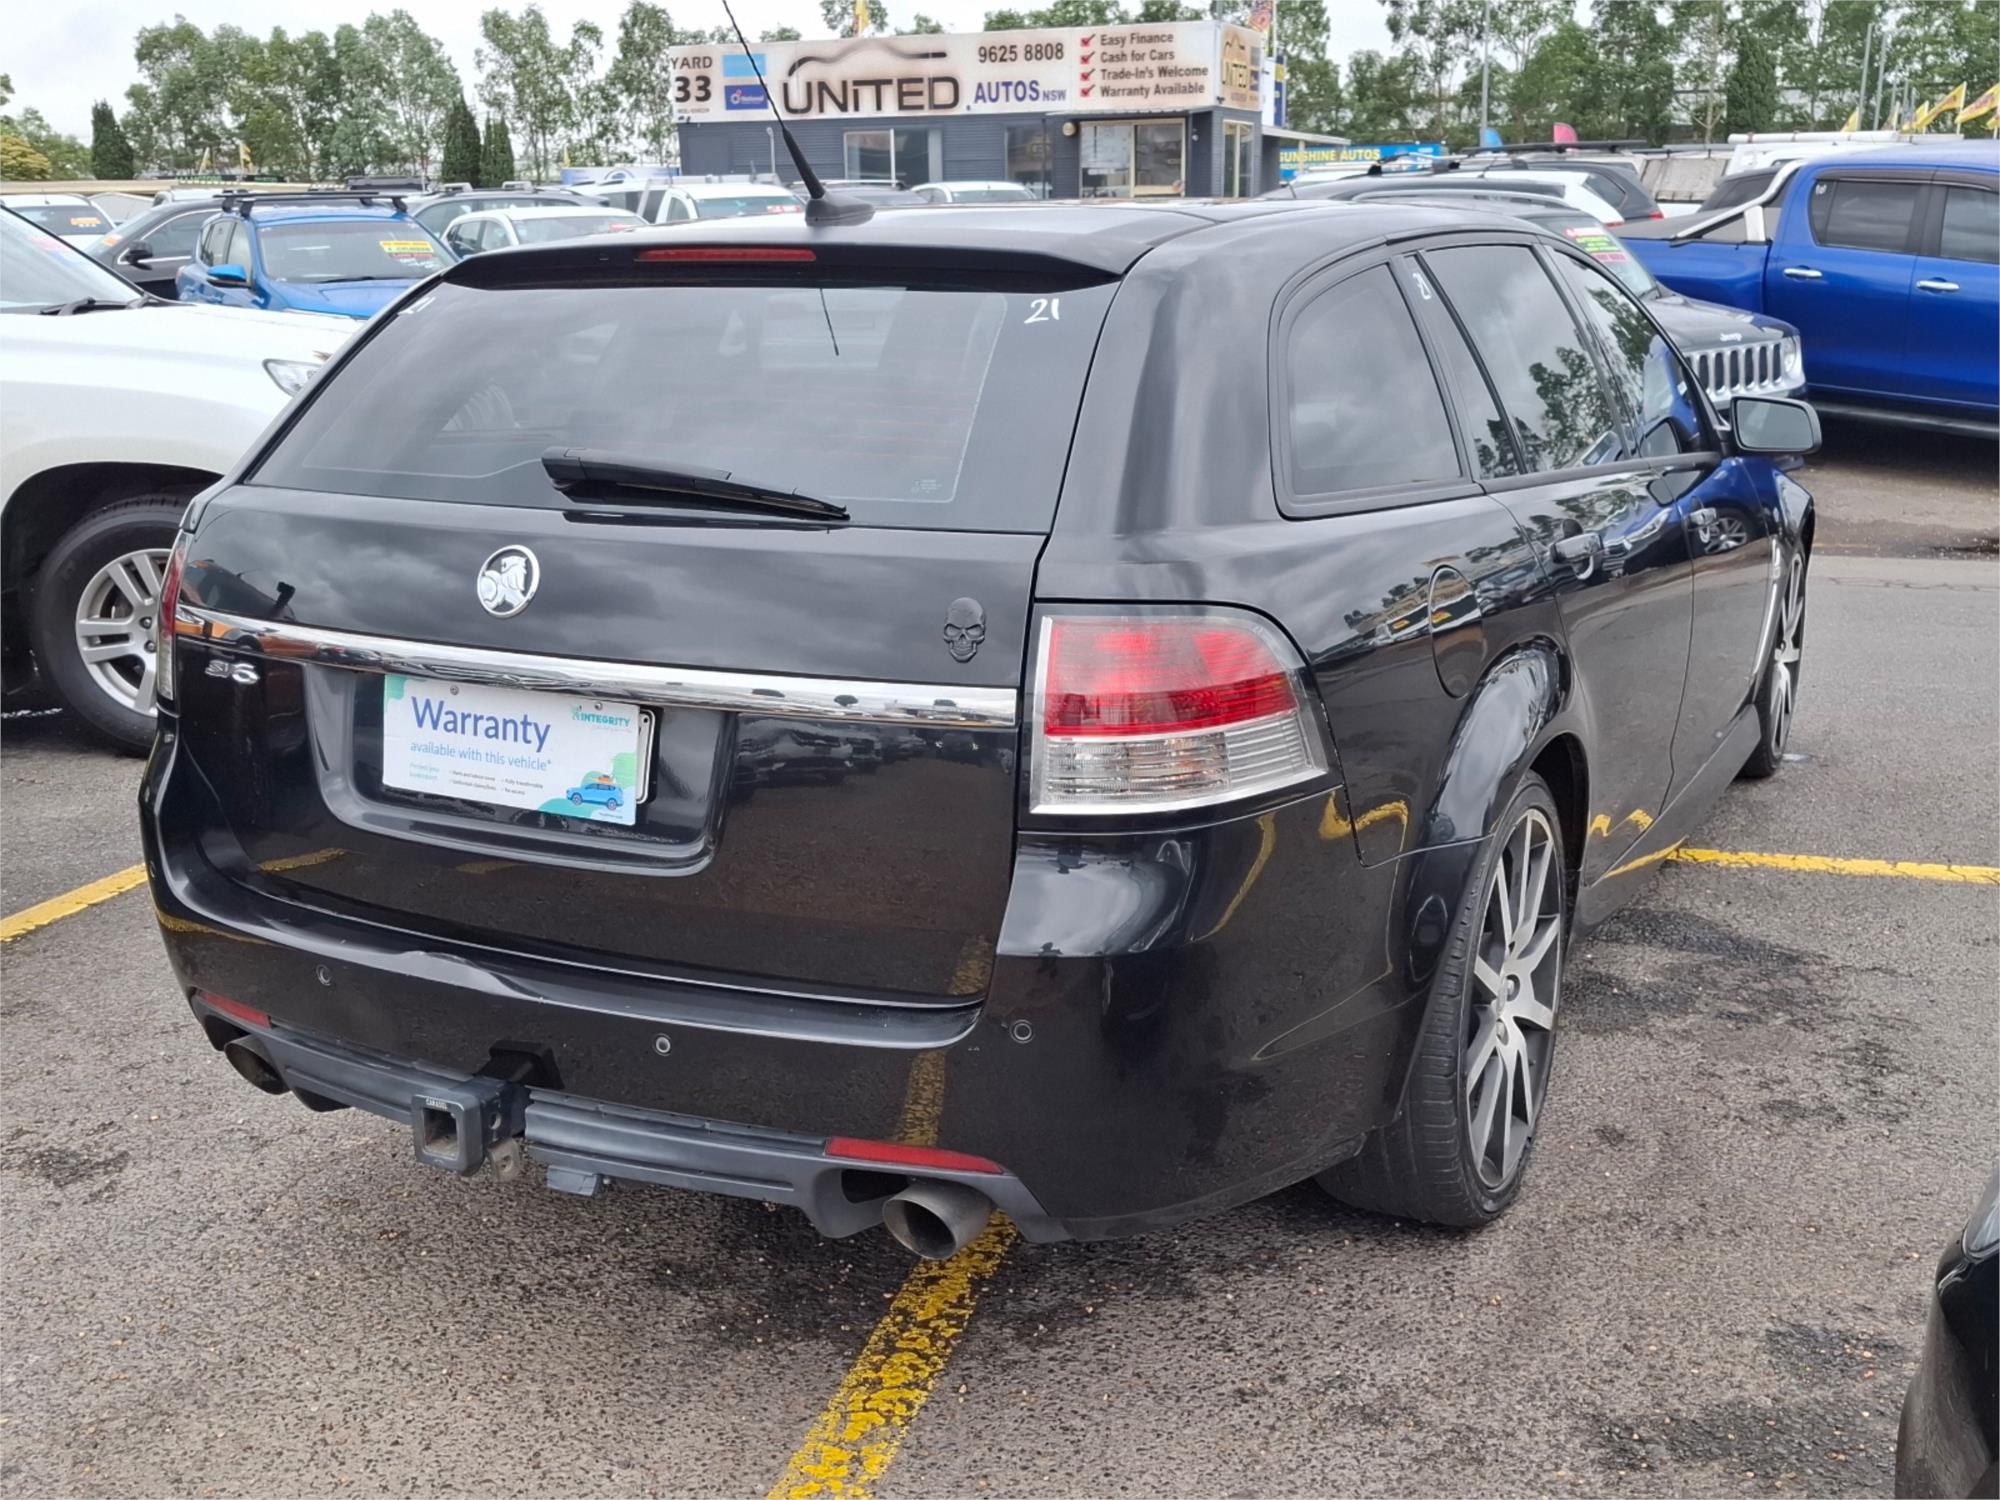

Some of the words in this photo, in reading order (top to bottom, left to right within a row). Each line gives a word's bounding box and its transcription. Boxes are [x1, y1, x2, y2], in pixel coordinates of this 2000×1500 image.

[1100, 34, 1127, 46] Easy
[1130, 32, 1174, 44] Finance
[978, 46, 1018, 63] 9625
[1024, 43, 1064, 61] 8808
[1100, 52, 1127, 63] Cash
[1131, 52, 1145, 62] for
[1149, 50, 1175, 61] Cars
[670, 56, 713, 69] YARD
[1101, 68, 1154, 80] Trade-In's
[1158, 65, 1209, 78] Welcome
[674, 75, 712, 103] 33
[974, 80, 1040, 104] AUTOS
[1042, 89, 1067, 102] NSW
[1101, 84, 1149, 98] Warranty
[1153, 82, 1205, 96] Available
[1341, 149, 1381, 160] AUTOS
[1024, 298, 1060, 324] 21
[411, 696, 551, 752] Warranty
[581, 710, 630, 728] INTEGRITY
[410, 740, 456, 758] available
[458, 745, 482, 762] with
[485, 751, 506, 766] this
